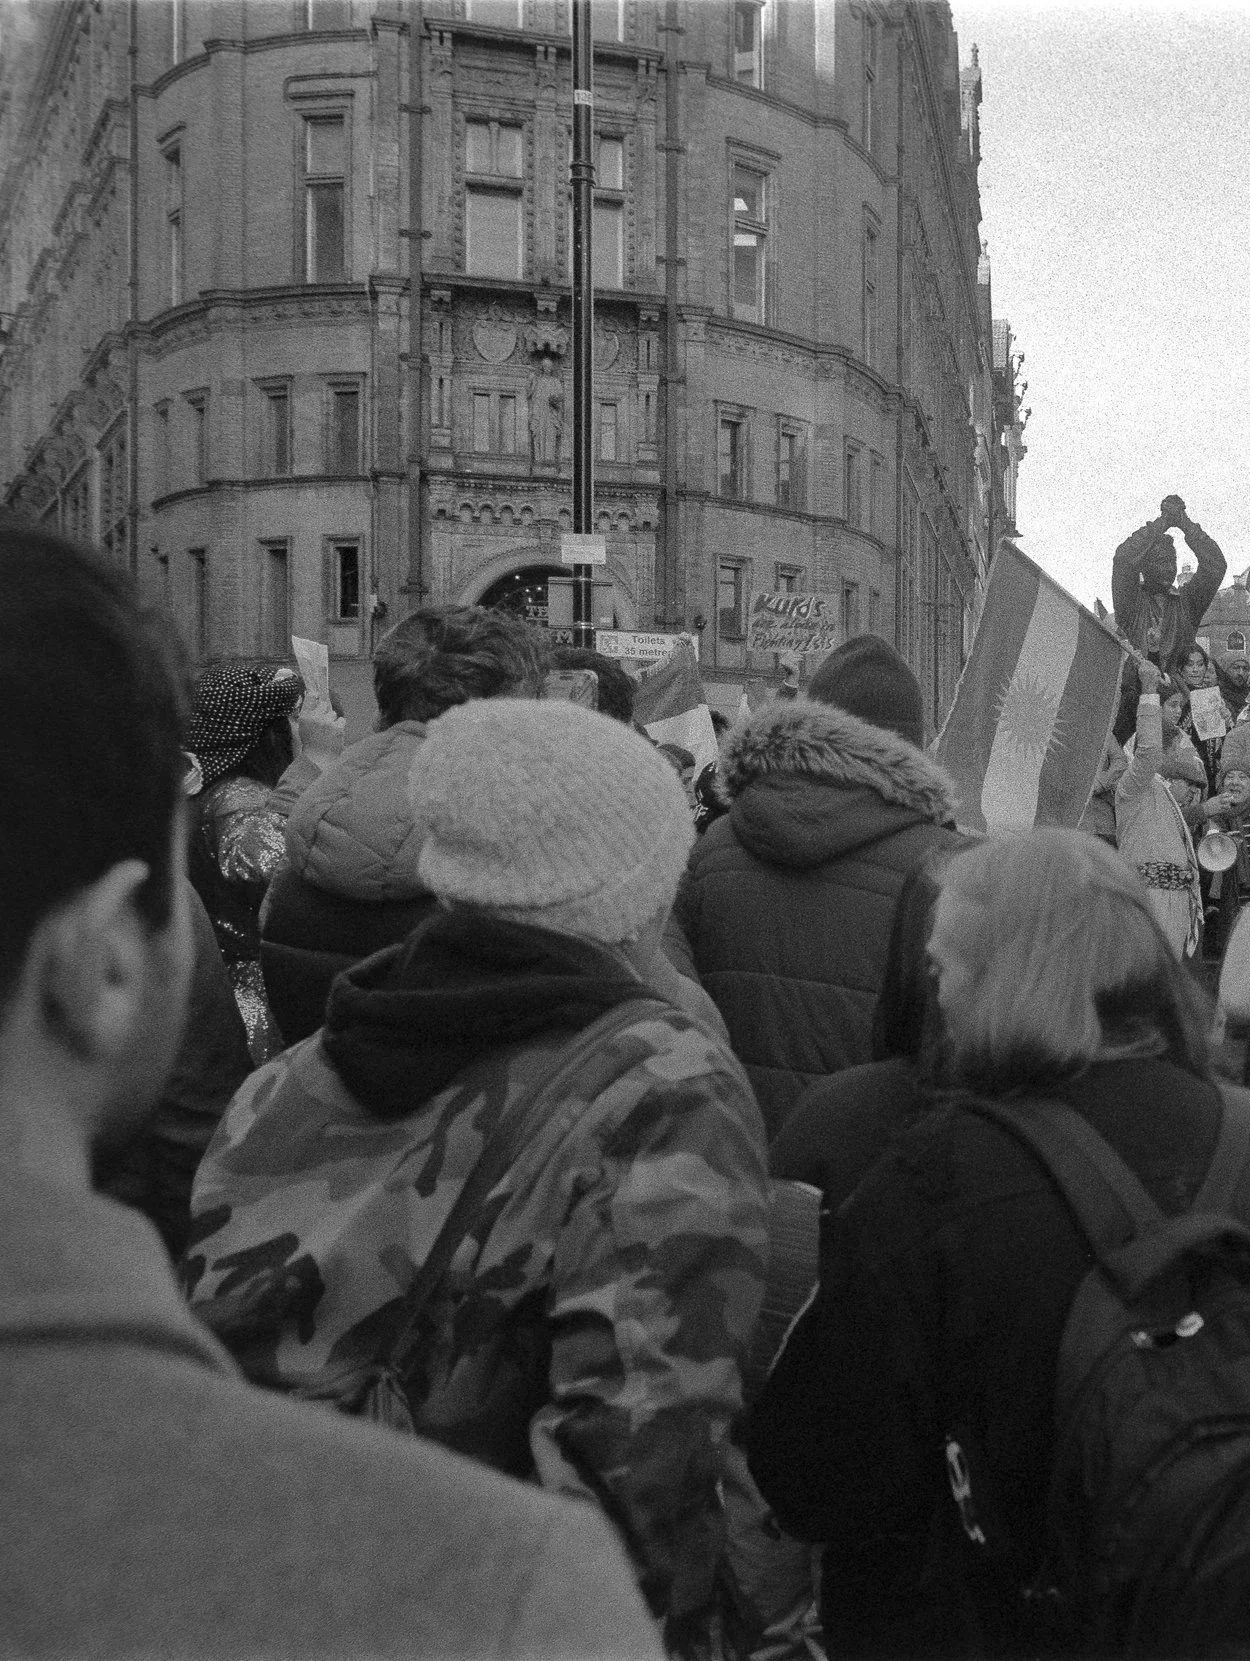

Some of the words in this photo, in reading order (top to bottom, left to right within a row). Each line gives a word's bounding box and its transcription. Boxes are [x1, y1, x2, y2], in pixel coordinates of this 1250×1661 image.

[631, 635, 666, 645] Toilets
[624, 647, 636, 655] 35
[639, 648, 670, 657] metre
